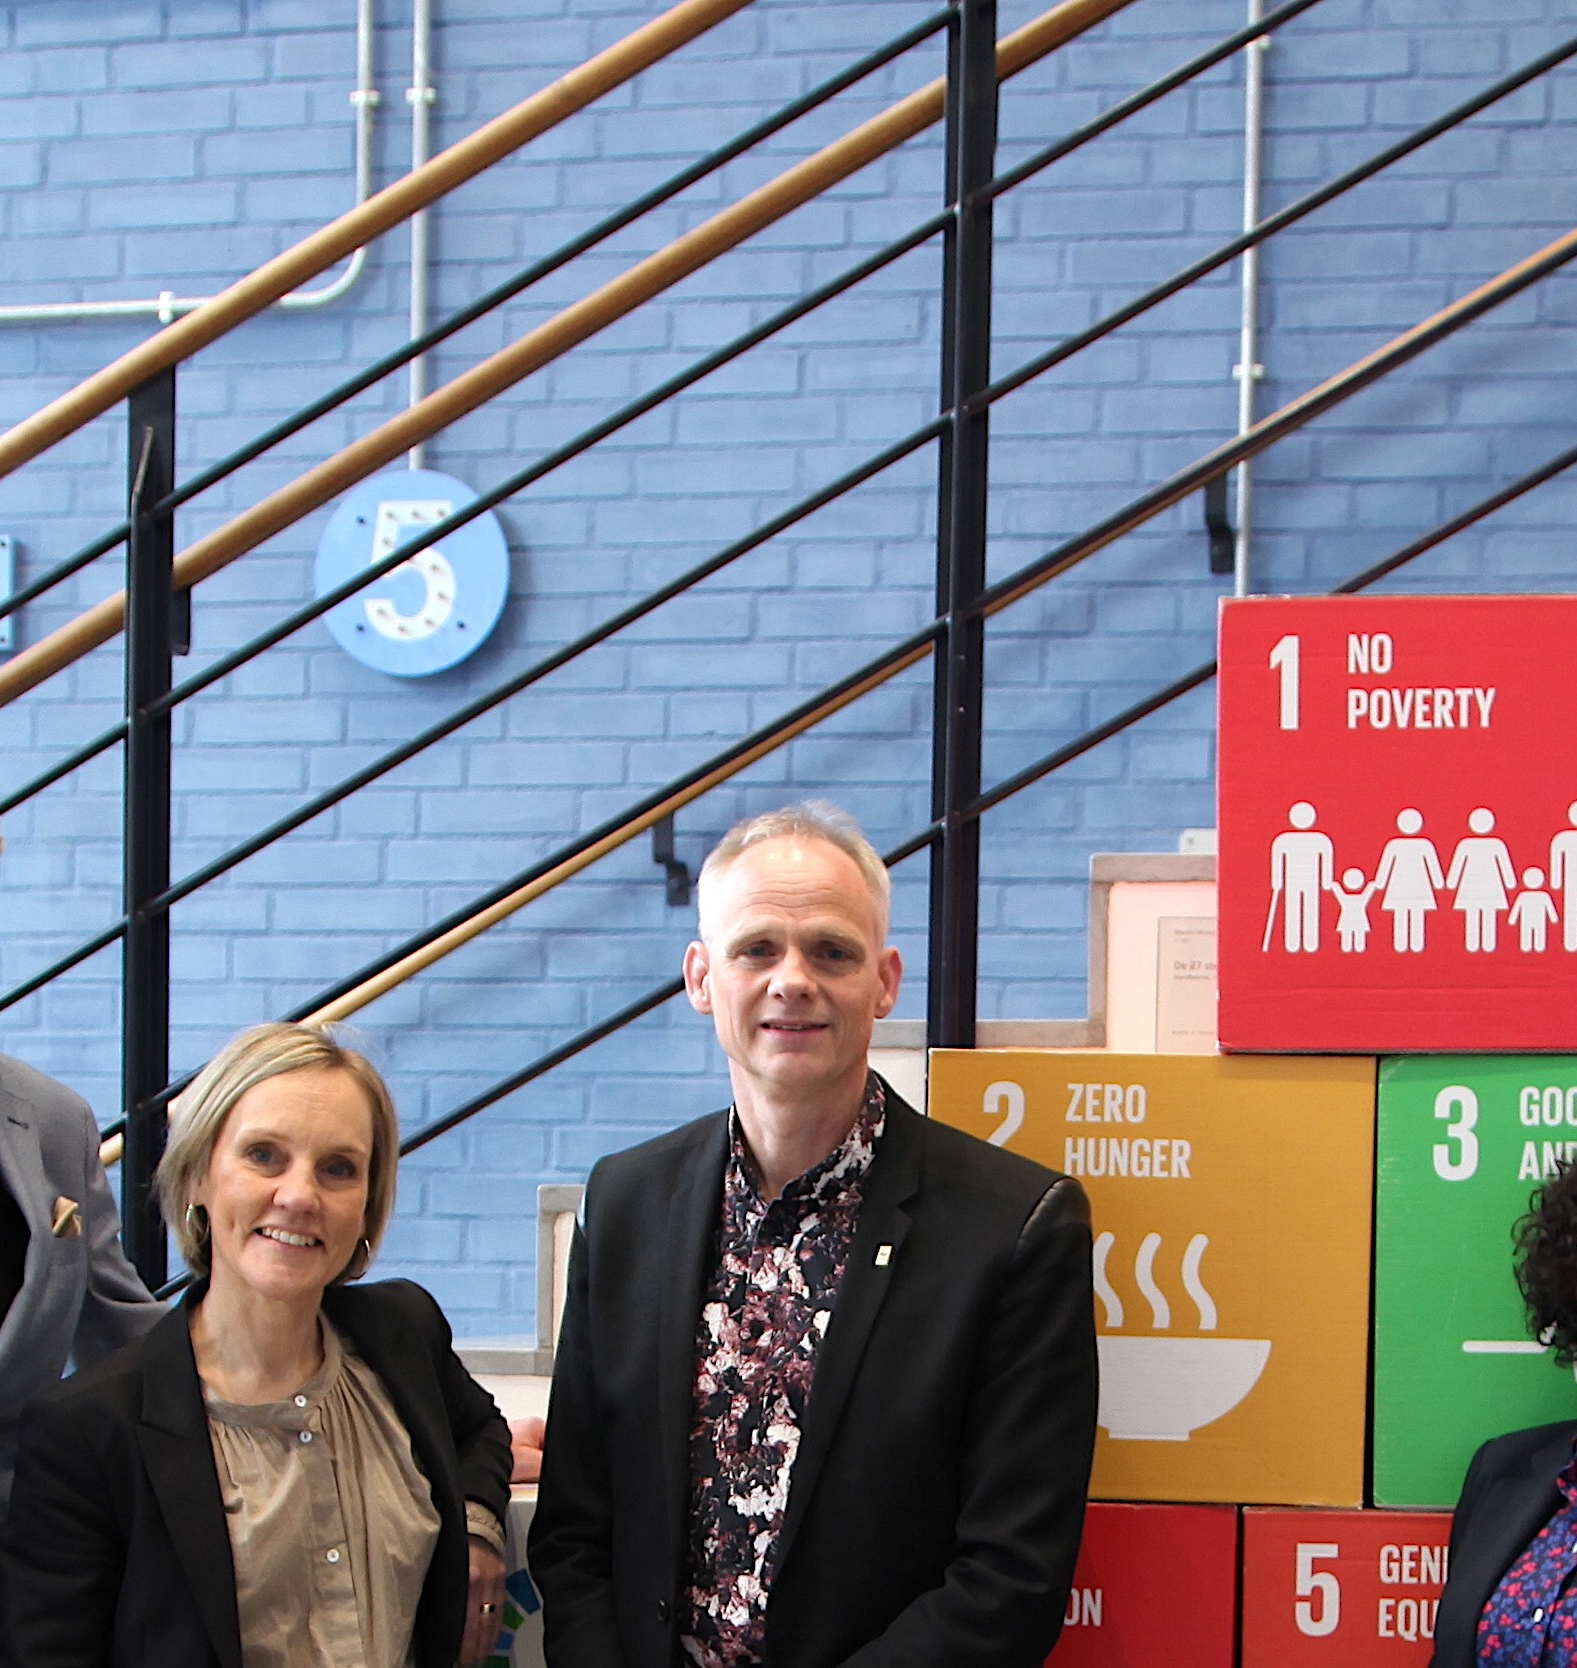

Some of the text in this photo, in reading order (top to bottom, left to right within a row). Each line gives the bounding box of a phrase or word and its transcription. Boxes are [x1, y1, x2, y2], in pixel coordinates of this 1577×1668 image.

[364, 500, 457, 642] 5
[1269, 635, 1299, 730] 1
[1347, 633, 1393, 674] NO
[1347, 687, 1497, 729] POVERTY
[983, 1081, 1025, 1148] 2
[1064, 1083, 1148, 1123] ZERO
[1433, 1085, 1479, 1181] 3
[1064, 1137, 1191, 1178] HUNGER
[1295, 1543, 1342, 1637] 5
